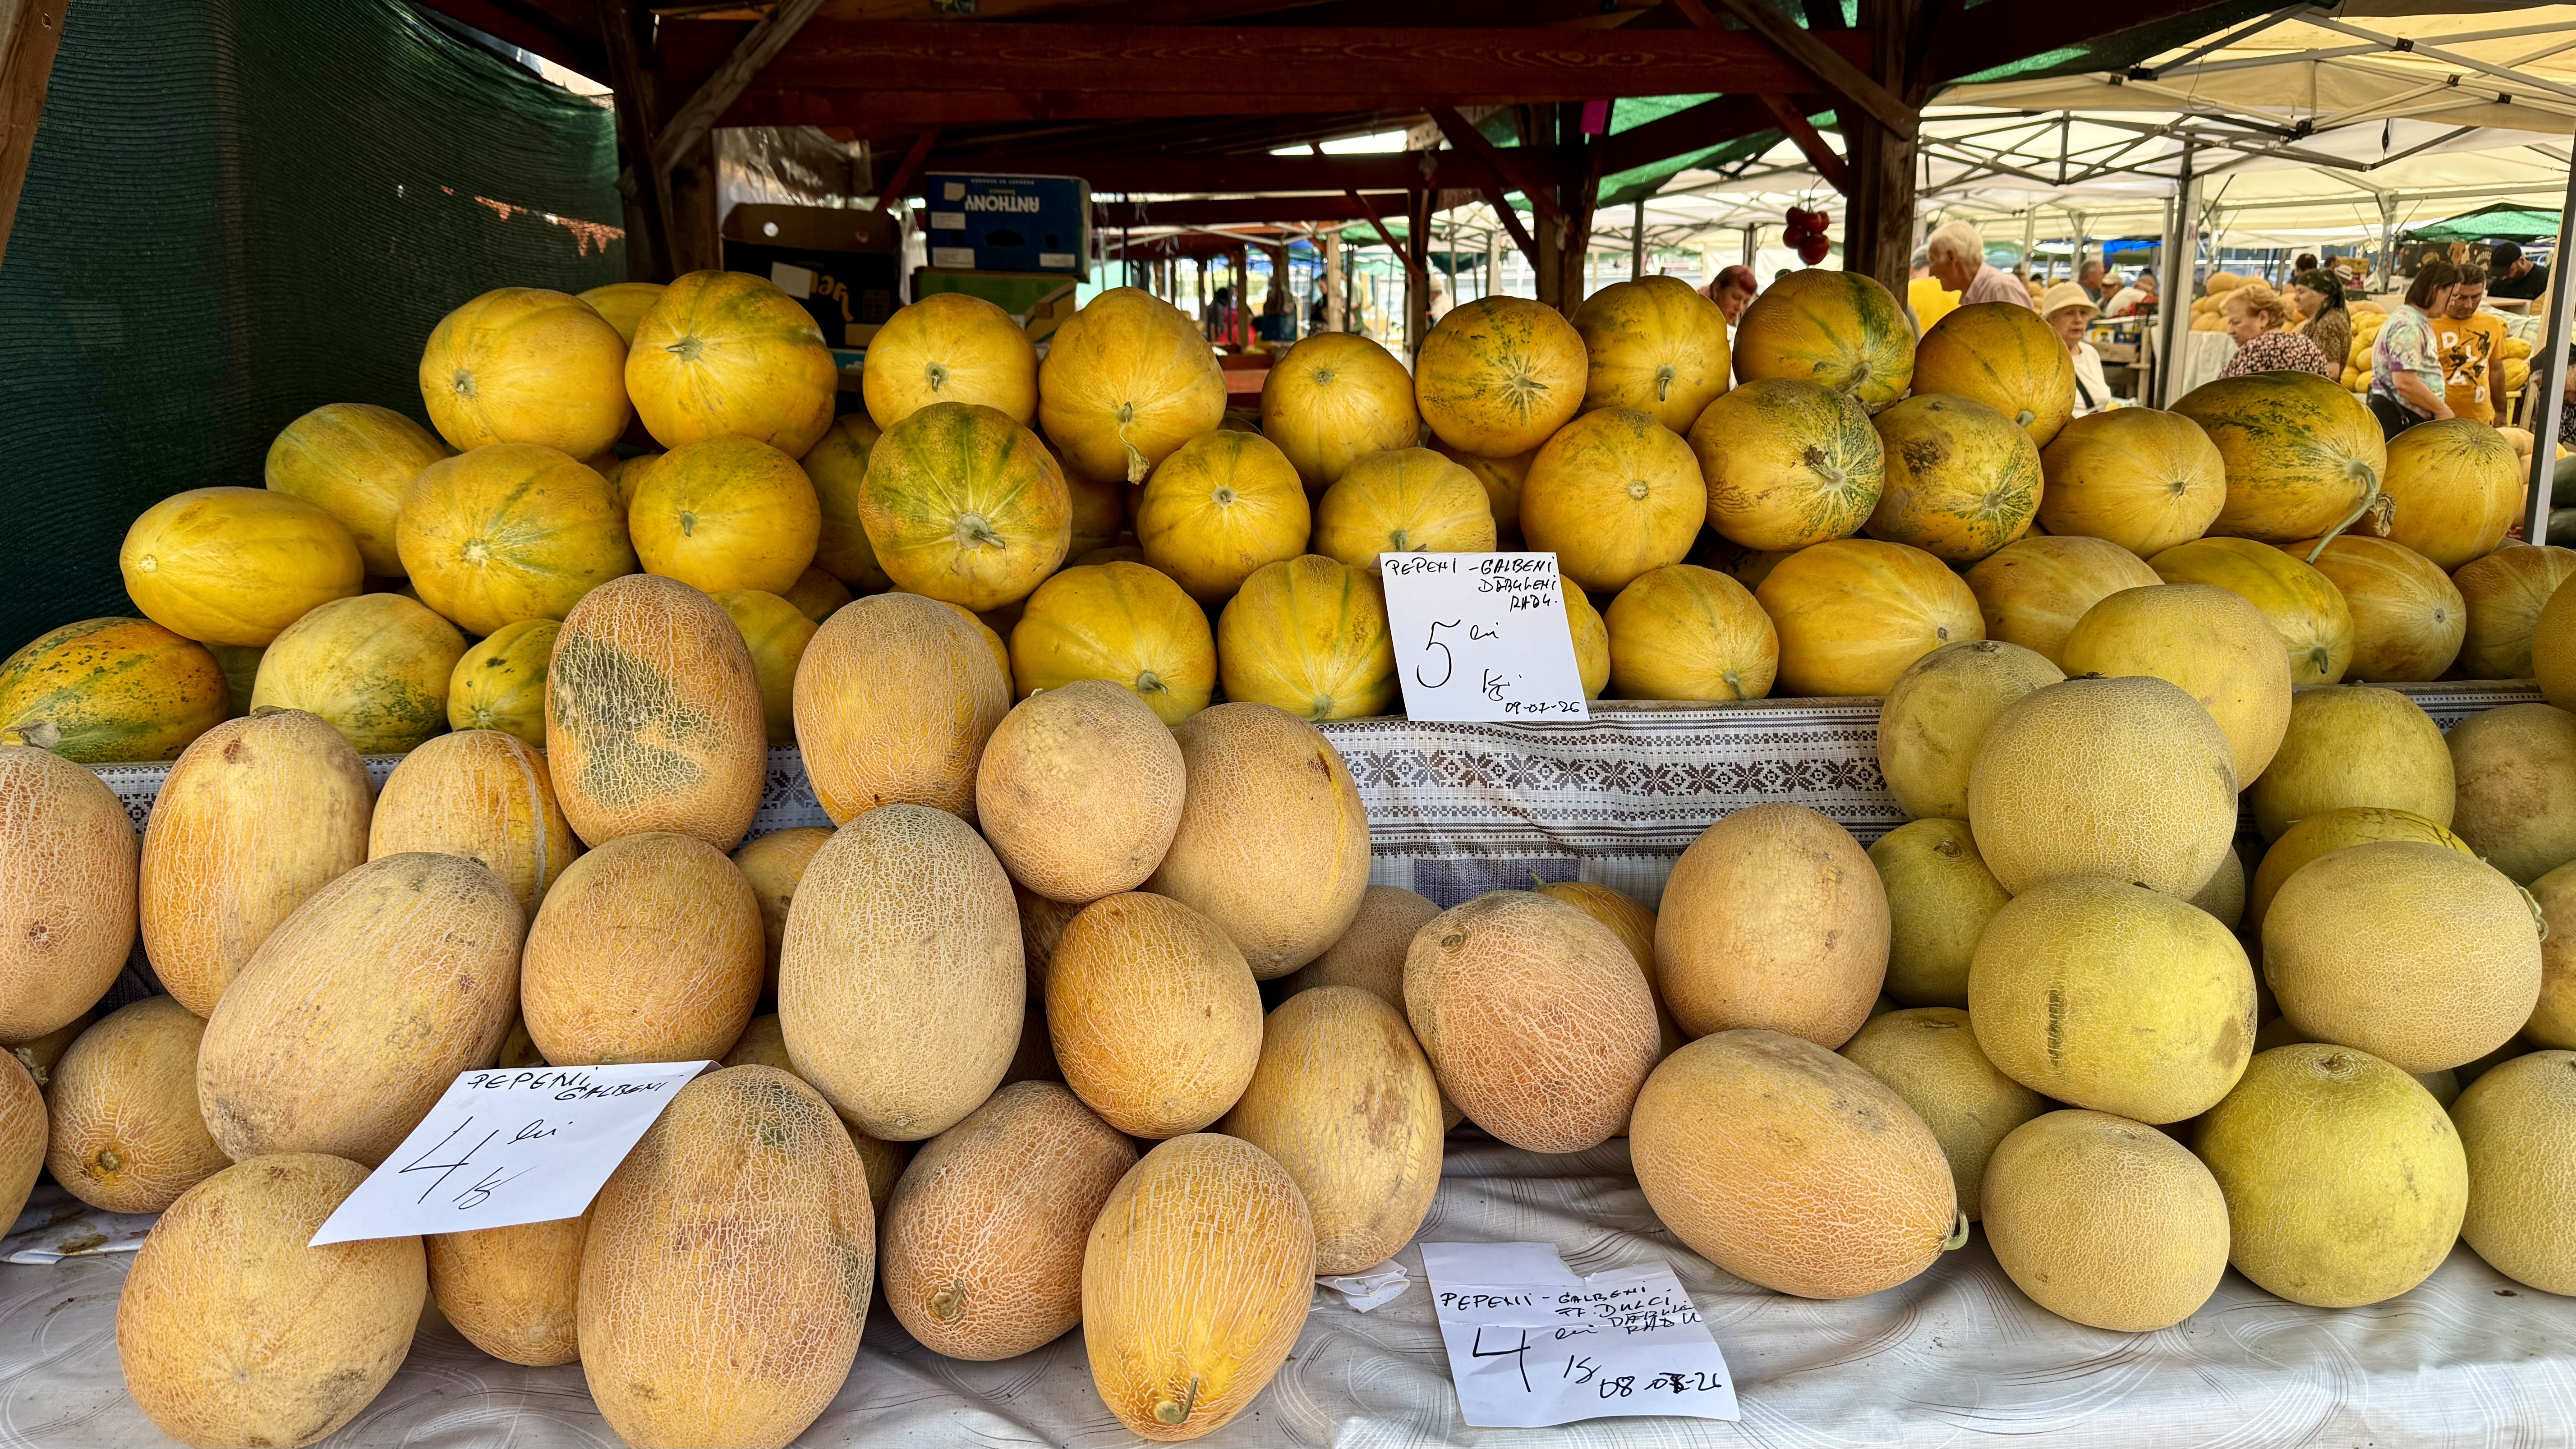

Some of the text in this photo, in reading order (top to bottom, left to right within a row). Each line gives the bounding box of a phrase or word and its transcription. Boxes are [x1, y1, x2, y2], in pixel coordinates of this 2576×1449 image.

[965, 194, 1040, 213] ANTHONY
[1417, 619, 1461, 688] 5
[398, 1116, 573, 1204] 4 lei
[1594, 1288, 1672, 1318] DULCI
[1472, 1328, 1531, 1393] 4
